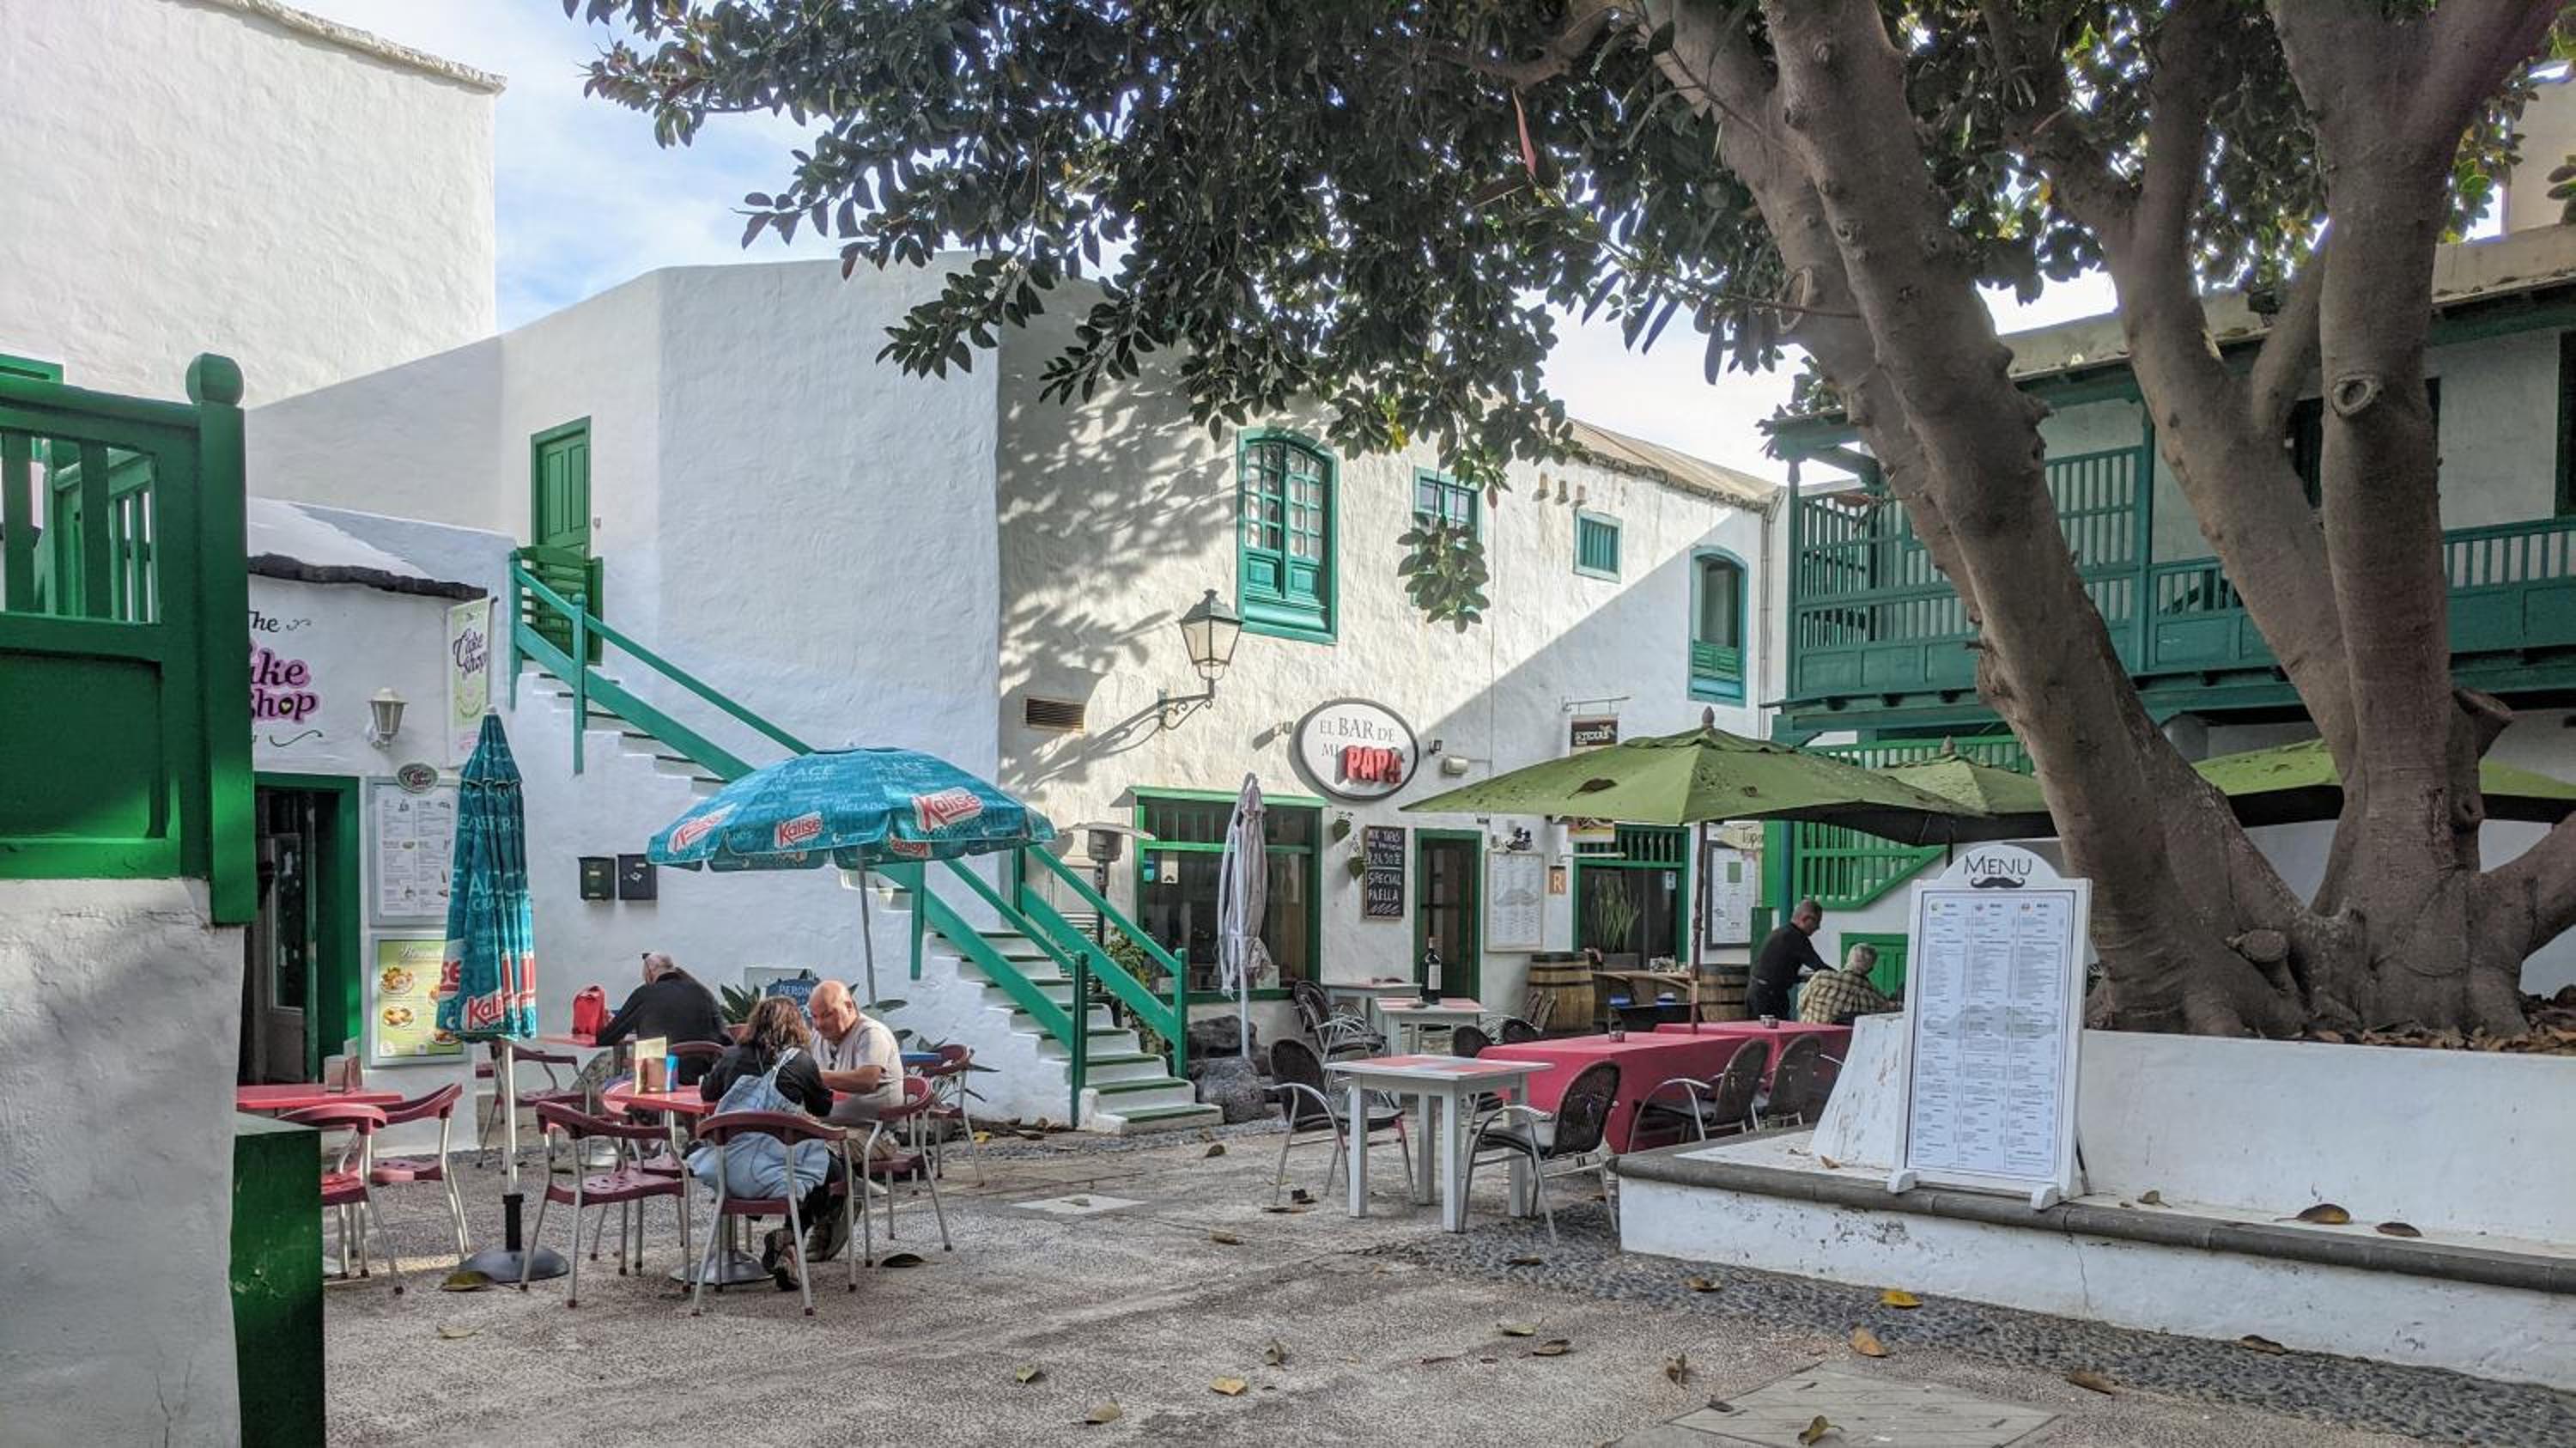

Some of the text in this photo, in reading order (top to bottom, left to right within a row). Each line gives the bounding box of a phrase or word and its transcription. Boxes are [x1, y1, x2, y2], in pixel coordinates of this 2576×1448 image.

[1320, 717, 1395, 742] EL BAR DE
[1322, 743, 1339, 756] MI
[911, 794, 981, 832] Kalise
[779, 817, 821, 845] Kalise
[1964, 855, 2032, 875] MENU
[1552, 873, 1564, 891] R
[1368, 887, 1399, 902] PAELLA
